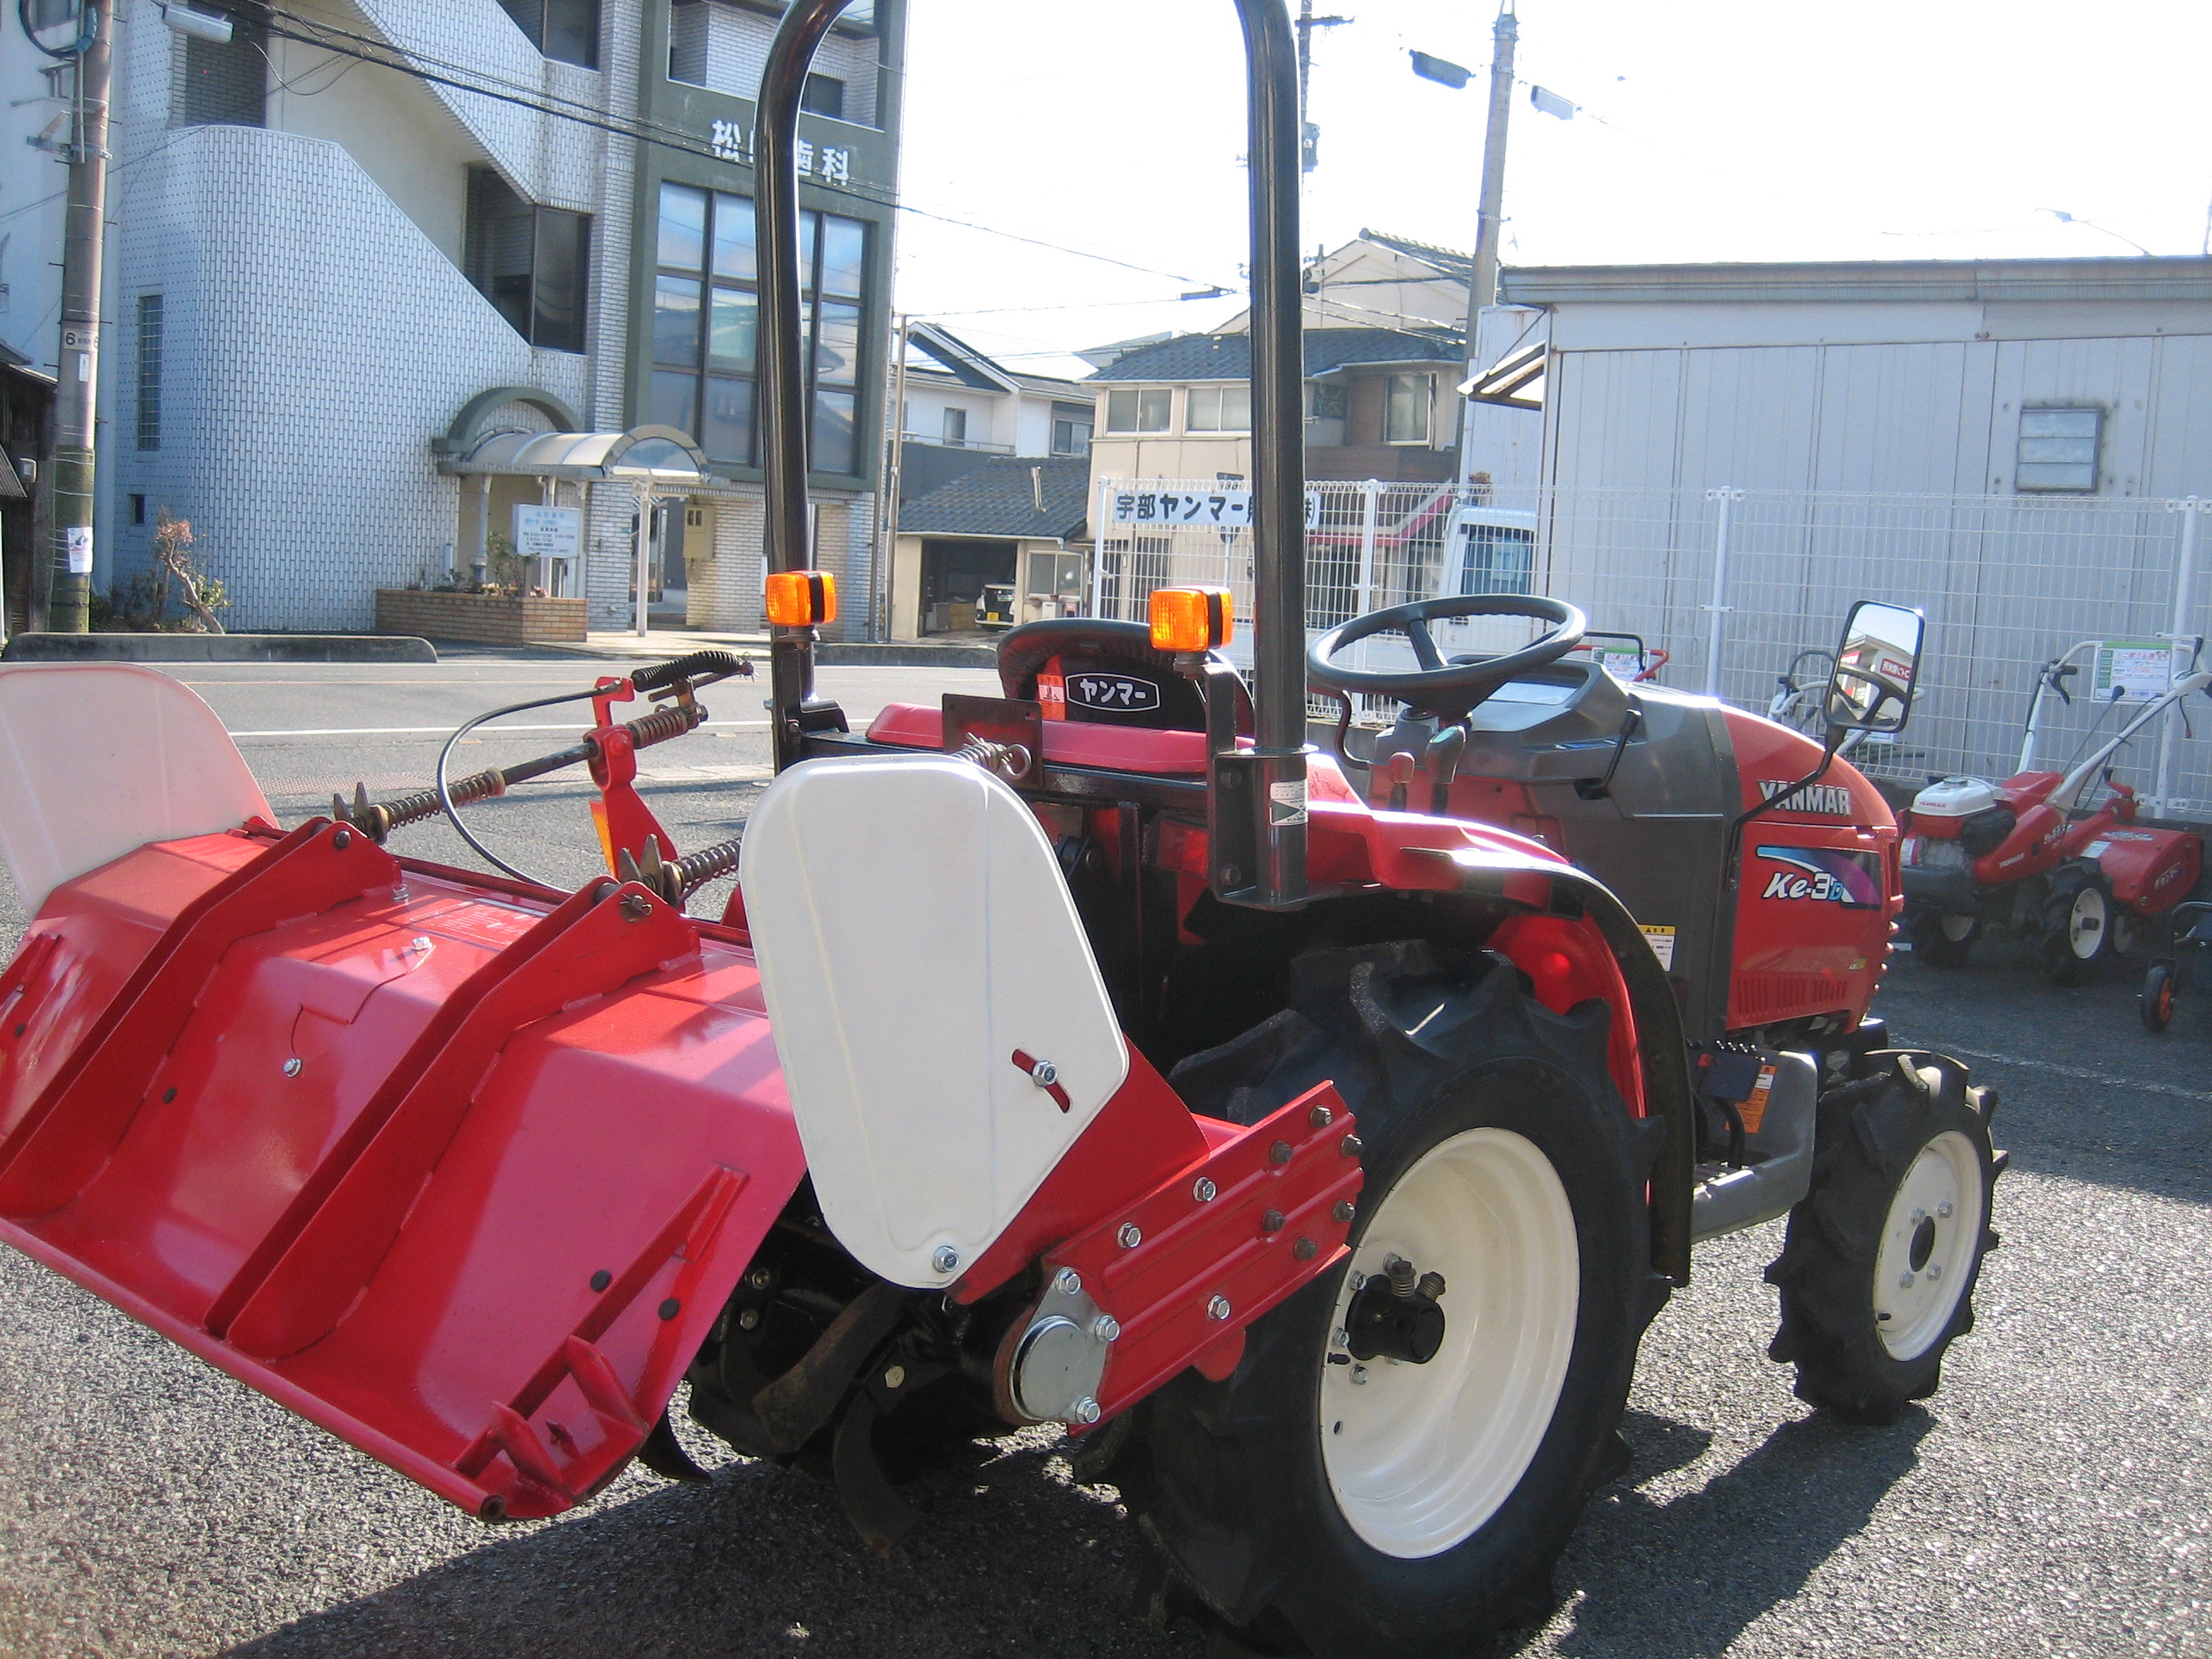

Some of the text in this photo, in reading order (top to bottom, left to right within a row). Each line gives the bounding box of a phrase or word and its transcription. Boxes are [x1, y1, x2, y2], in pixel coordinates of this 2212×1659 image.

[712, 119, 849, 186] 松歯科
[66, 332, 76, 346] 6
[1080, 678, 1146, 706] ヤンマー
[1758, 780, 1850, 816] YANMAR
